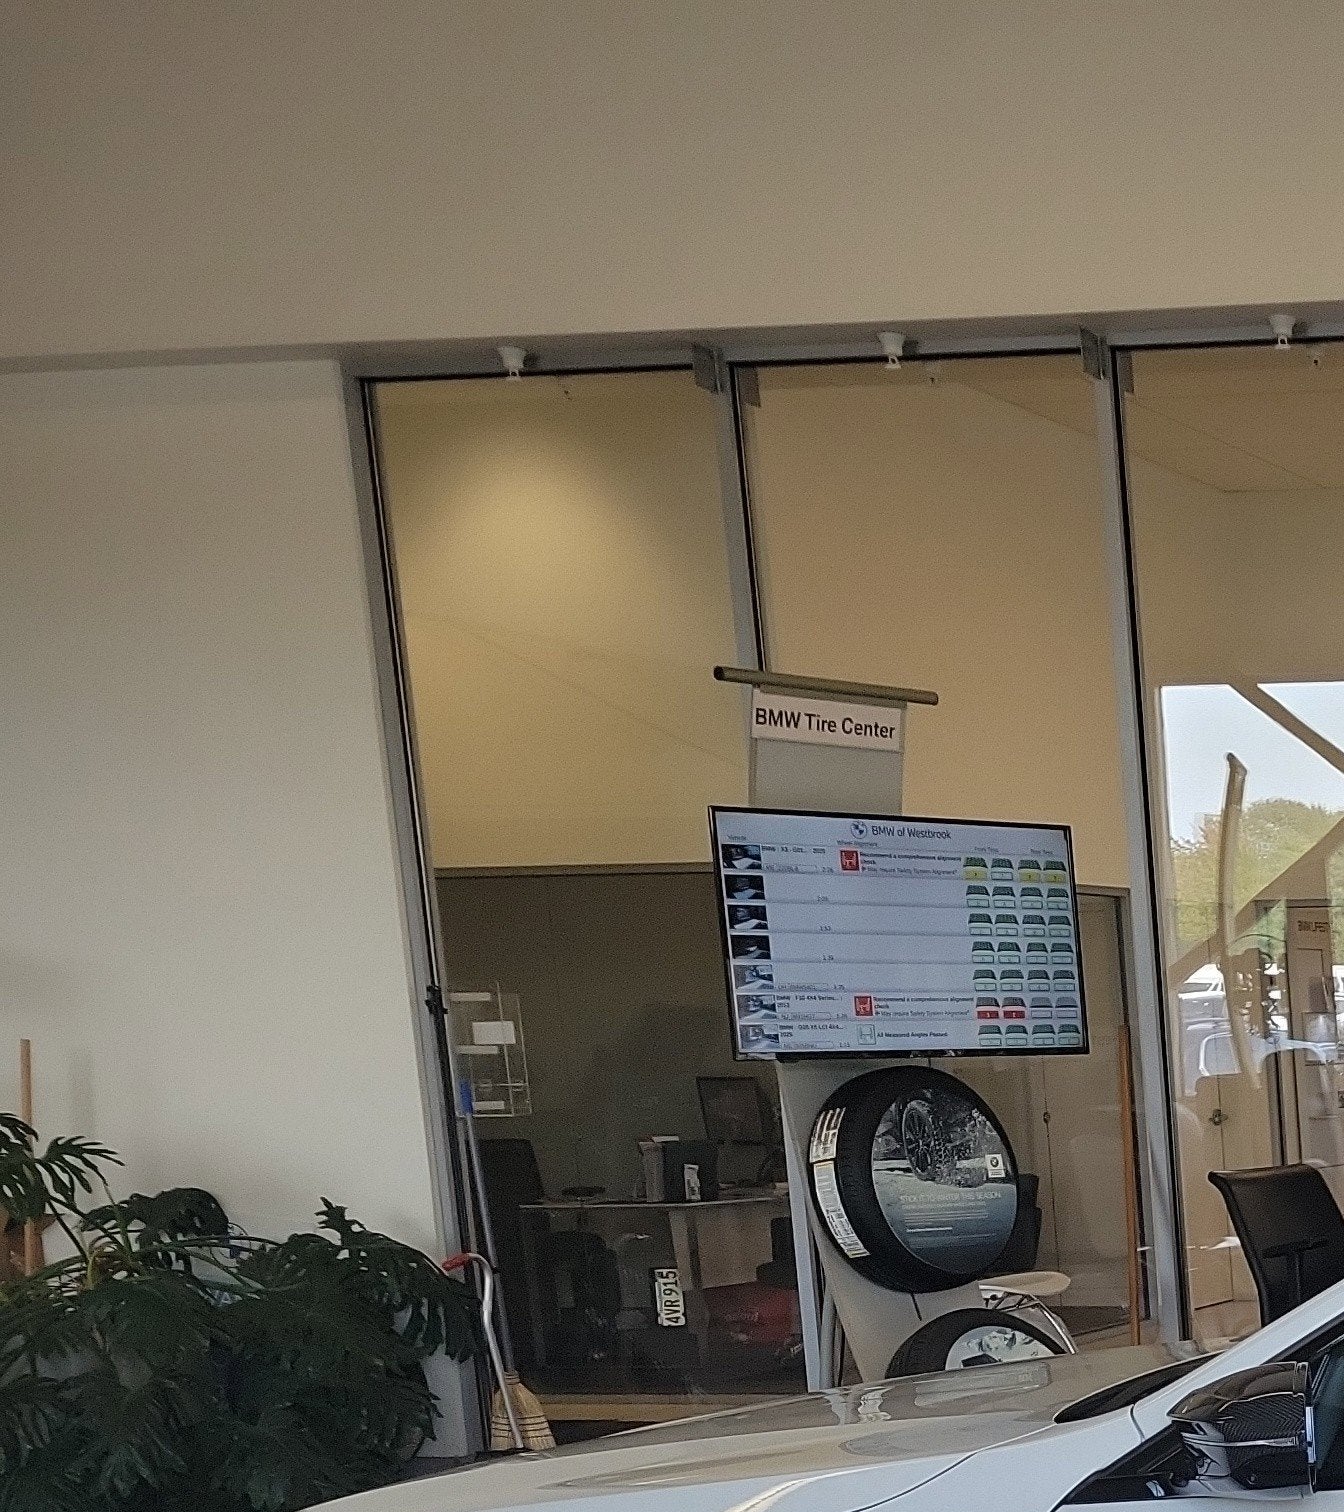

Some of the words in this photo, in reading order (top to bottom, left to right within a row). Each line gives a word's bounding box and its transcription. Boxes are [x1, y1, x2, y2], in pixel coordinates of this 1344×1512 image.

[755, 707, 801, 730] BMW
[804, 712, 837, 733] Tire
[841, 717, 896, 739] Center
[871, 825, 895, 837] BMW
[897, 826, 905, 837] of
[907, 827, 952, 840] Westbrook
[662, 1270, 679, 1296] 915
